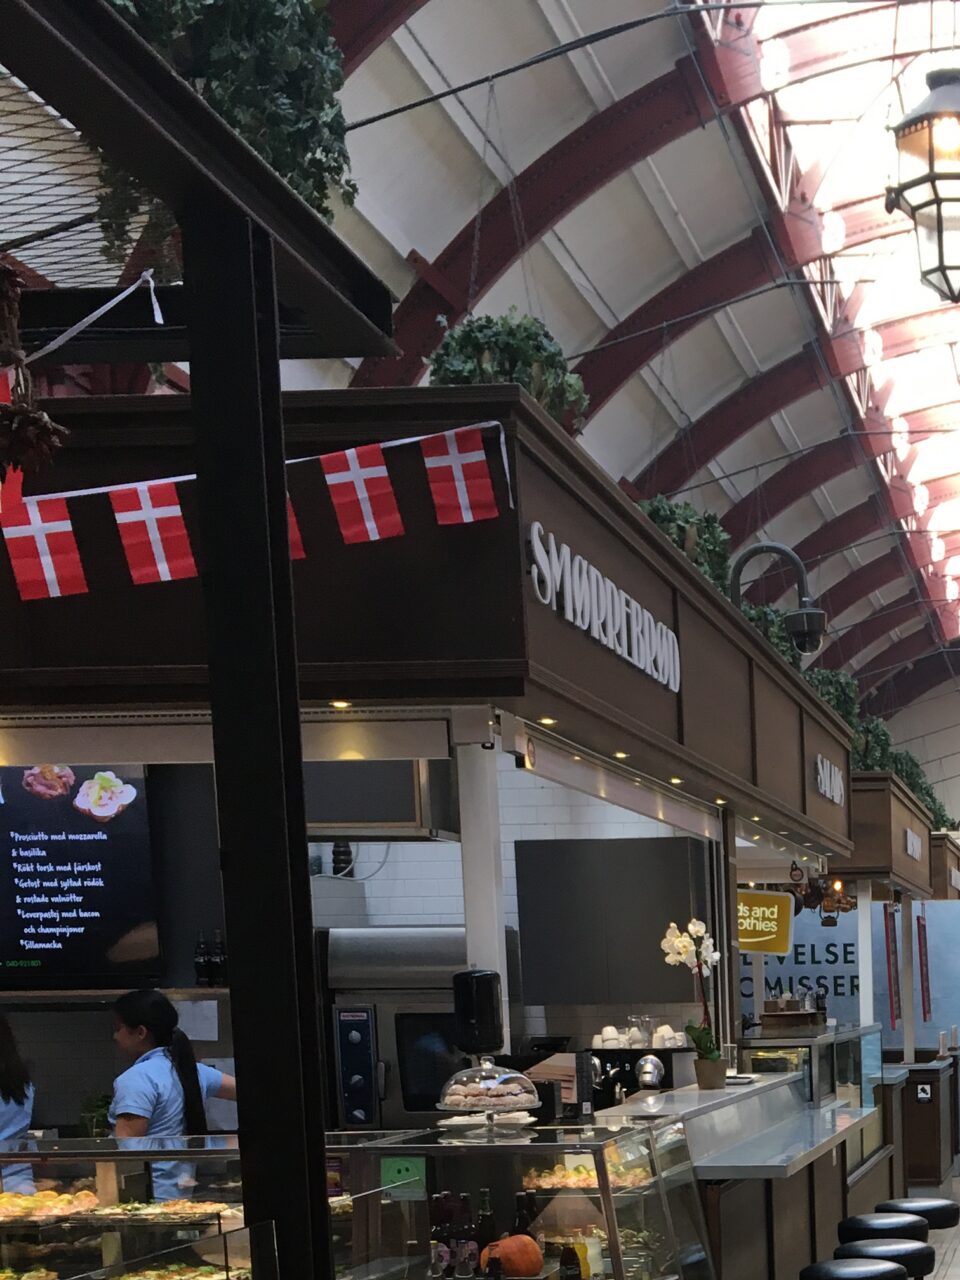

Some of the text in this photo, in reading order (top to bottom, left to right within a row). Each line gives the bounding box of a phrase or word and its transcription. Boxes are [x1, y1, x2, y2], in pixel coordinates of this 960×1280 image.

[15, 831, 107, 842] Prosciutto med mozzarella
[19, 847, 47, 857] basilika
[17, 862, 102, 874] Rökt torsk med färskost
[18, 878, 41, 888] Getost
[42, 878, 58, 888] med
[60, 878, 82, 890] syltad
[24, 893, 49, 904] rostade
[51, 893, 83, 903] valnötter
[21, 908, 100, 922] Leverpastej med bacon
[751, 904, 778, 919] and
[24, 924, 85, 937] och champinjoner
